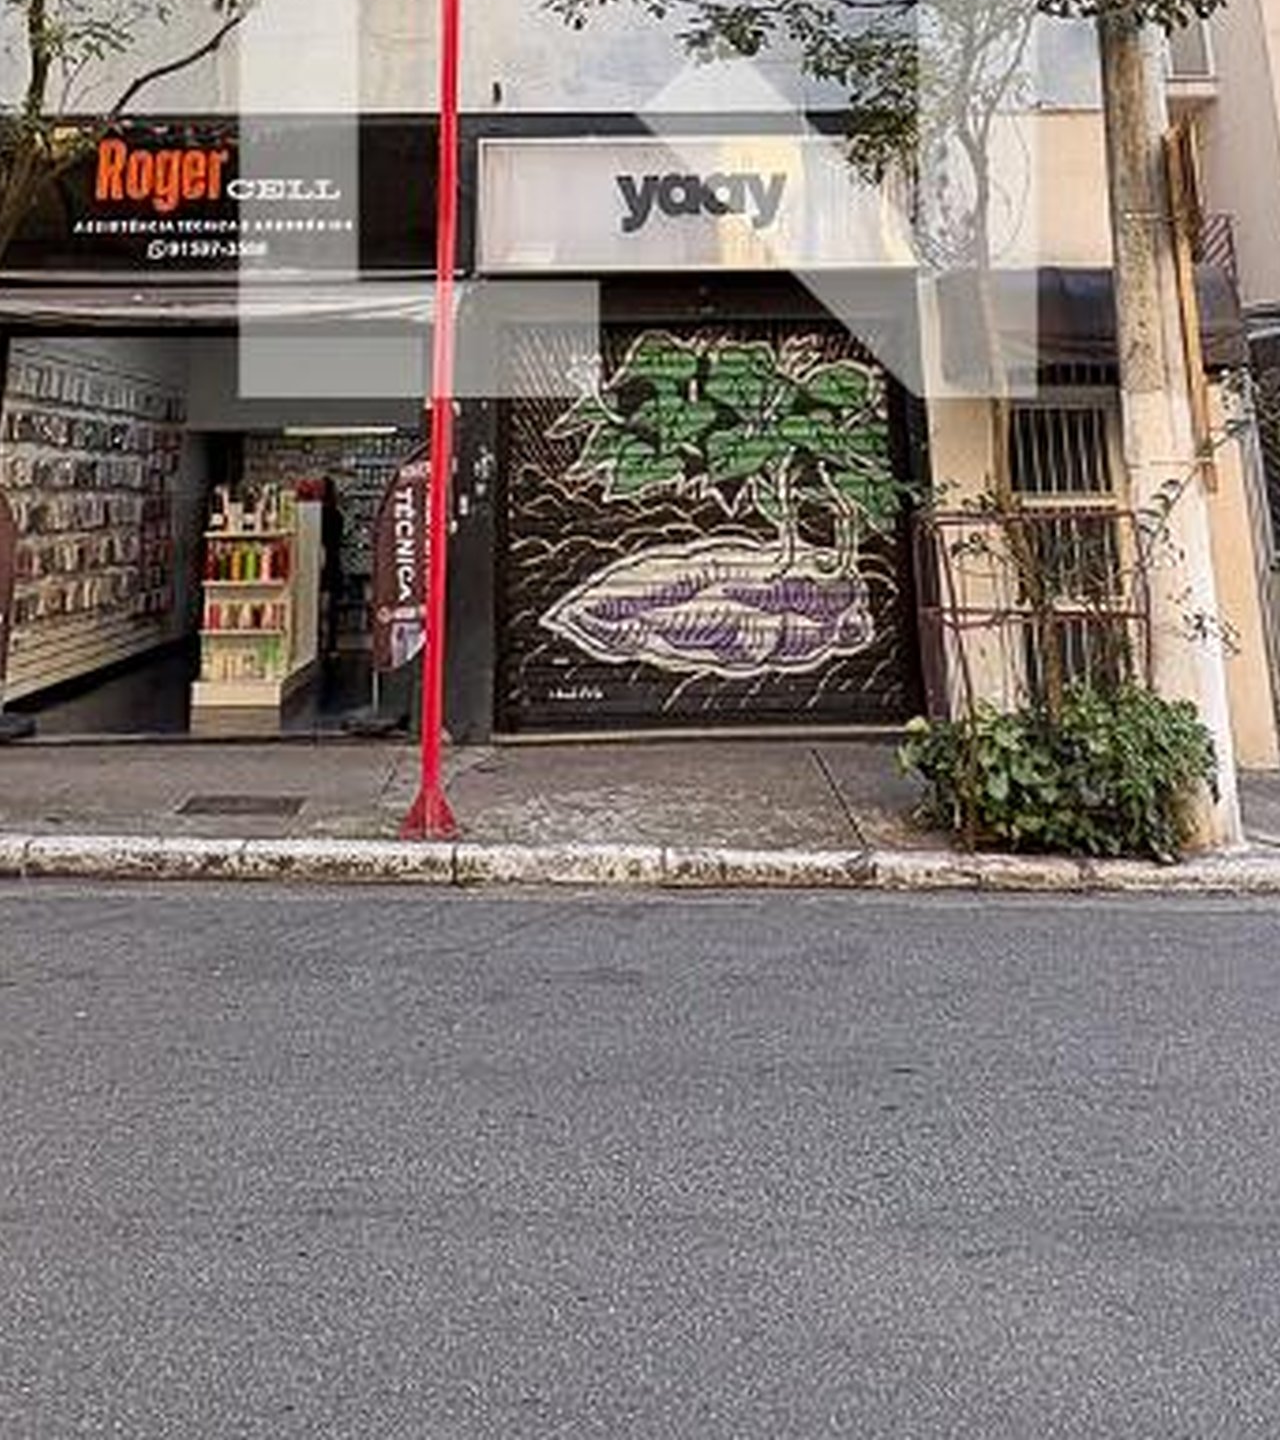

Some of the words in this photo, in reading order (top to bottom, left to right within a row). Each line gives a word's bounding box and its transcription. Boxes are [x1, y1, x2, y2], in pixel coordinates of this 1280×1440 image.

[95, 139, 229, 212] Roger
[227, 179, 342, 201] CELL
[615, 172, 787, 233] yaay
